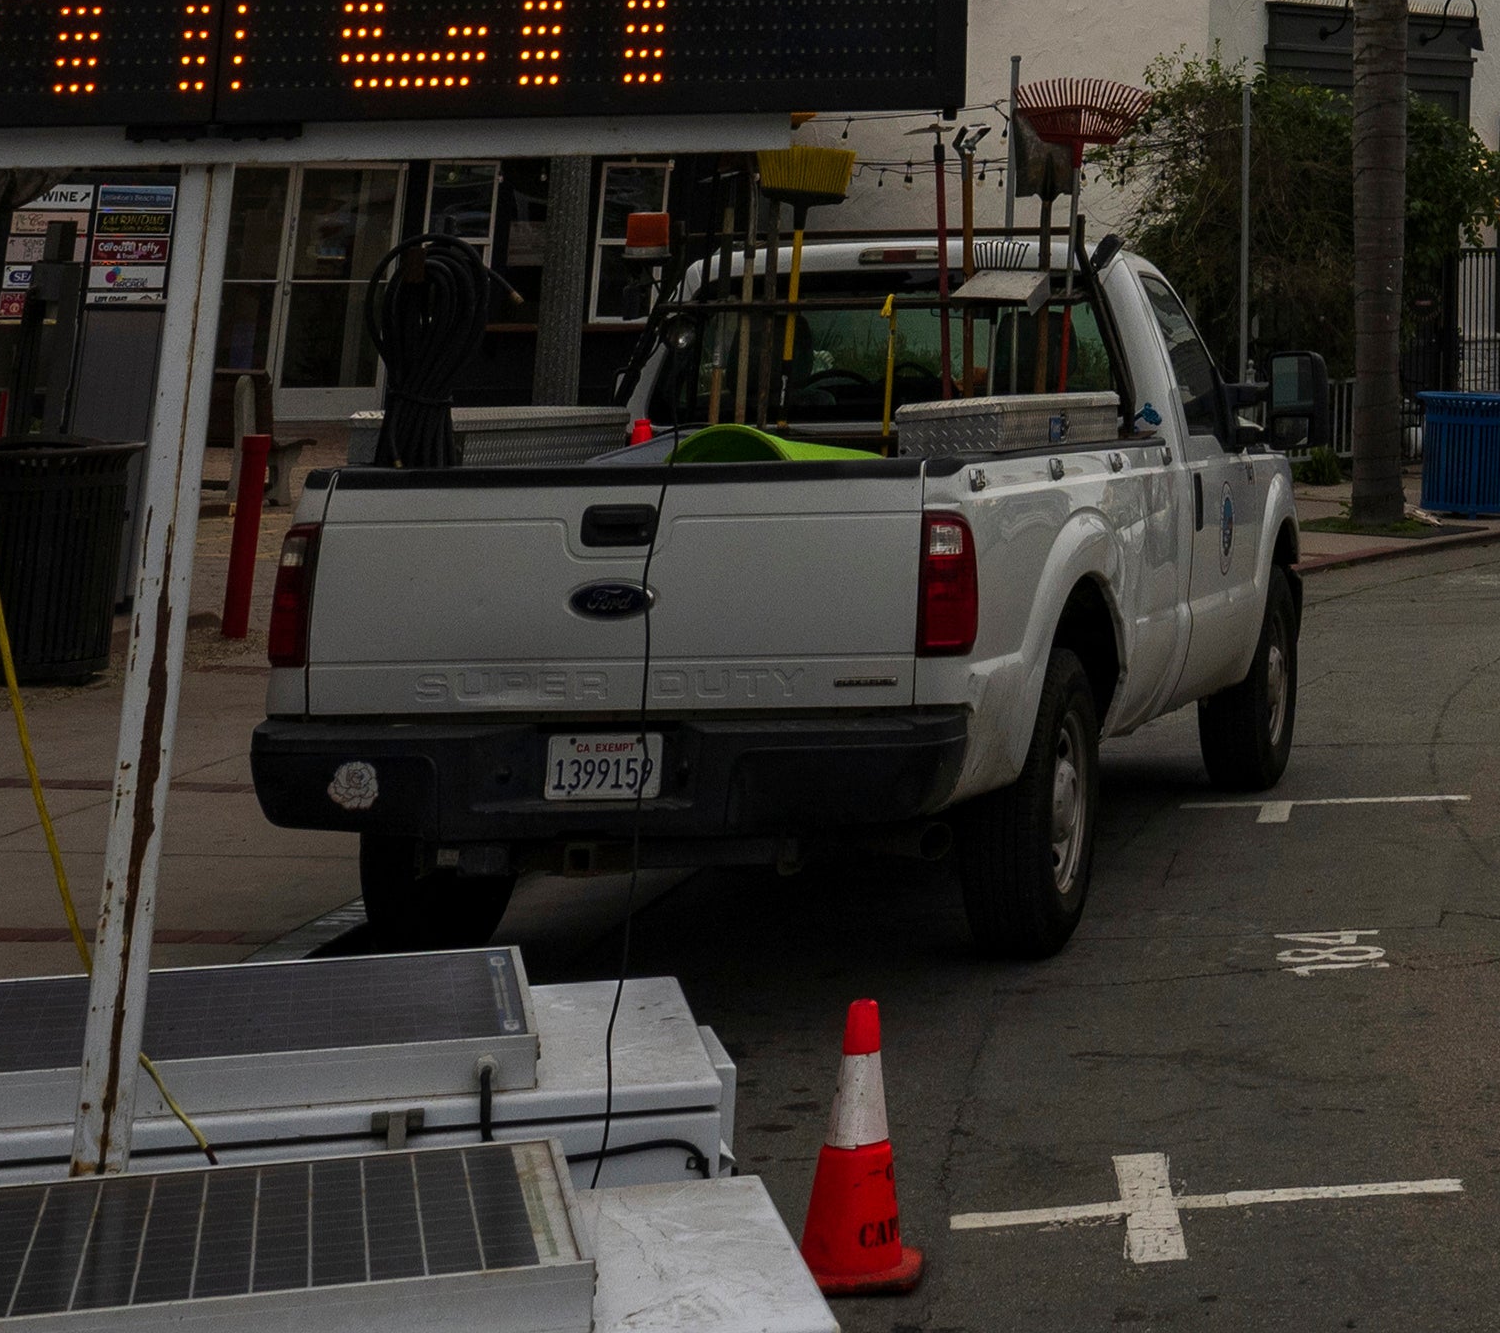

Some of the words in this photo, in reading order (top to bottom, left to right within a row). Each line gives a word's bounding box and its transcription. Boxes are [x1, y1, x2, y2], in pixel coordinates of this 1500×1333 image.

[42, 191, 79, 203] WINE
[138, 242, 161, 253] Taffy
[587, 587, 632, 610] Ford
[414, 670, 609, 703] SUPER
[652, 669, 805, 700] DUTY
[576, 743, 590, 753] CA
[595, 742, 636, 753] EXEMPT
